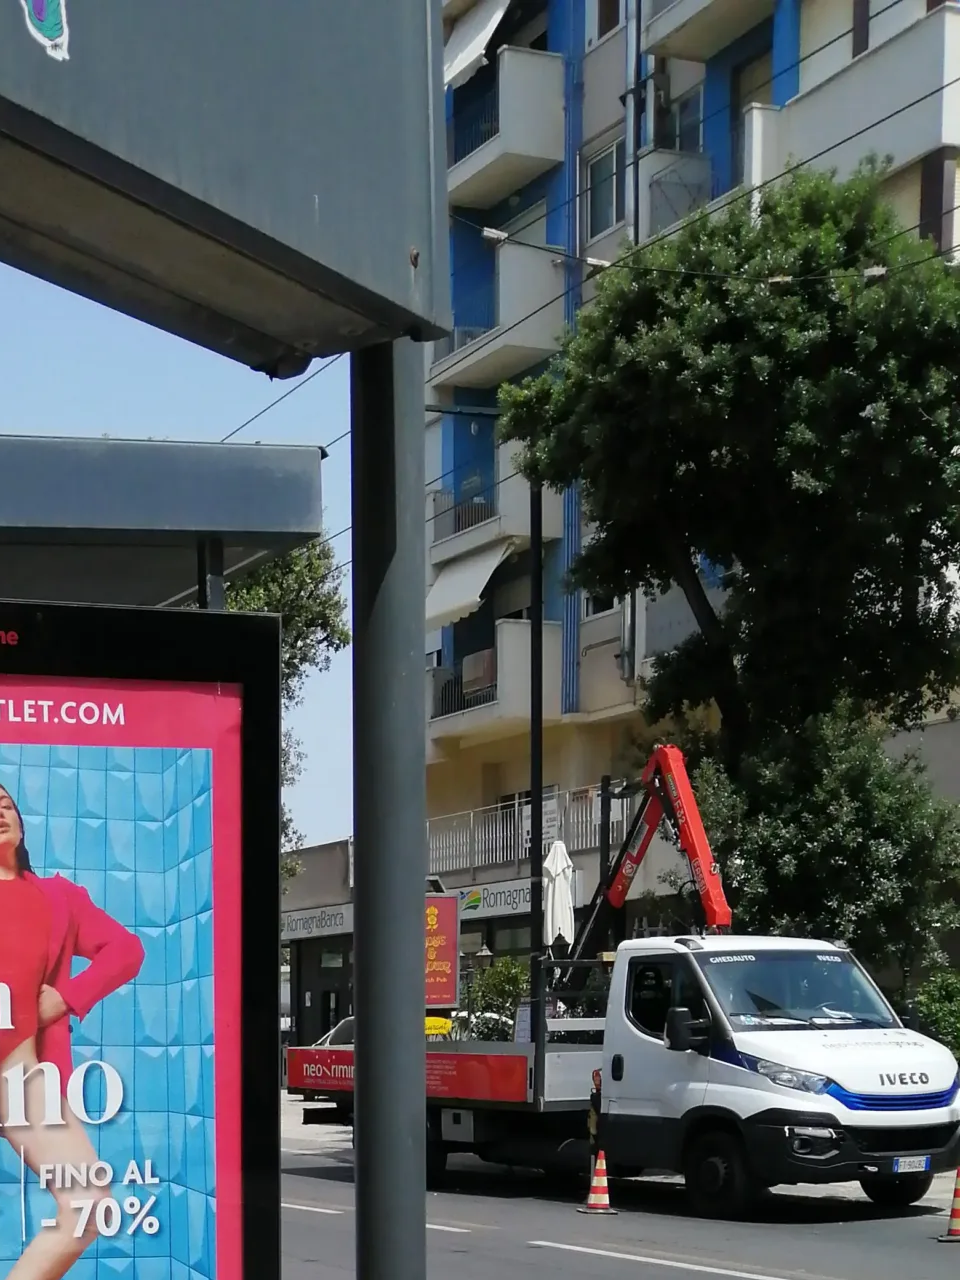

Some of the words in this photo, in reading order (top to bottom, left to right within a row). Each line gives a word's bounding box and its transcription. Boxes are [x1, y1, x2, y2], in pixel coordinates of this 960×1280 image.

[286, 910, 345, 935] RomagnaBanca
[816, 954, 842, 963] IVECO
[878, 1072, 930, 1086] IVECO
[40, 1160, 114, 1189] FINO
[122, 1159, 160, 1185] AL
